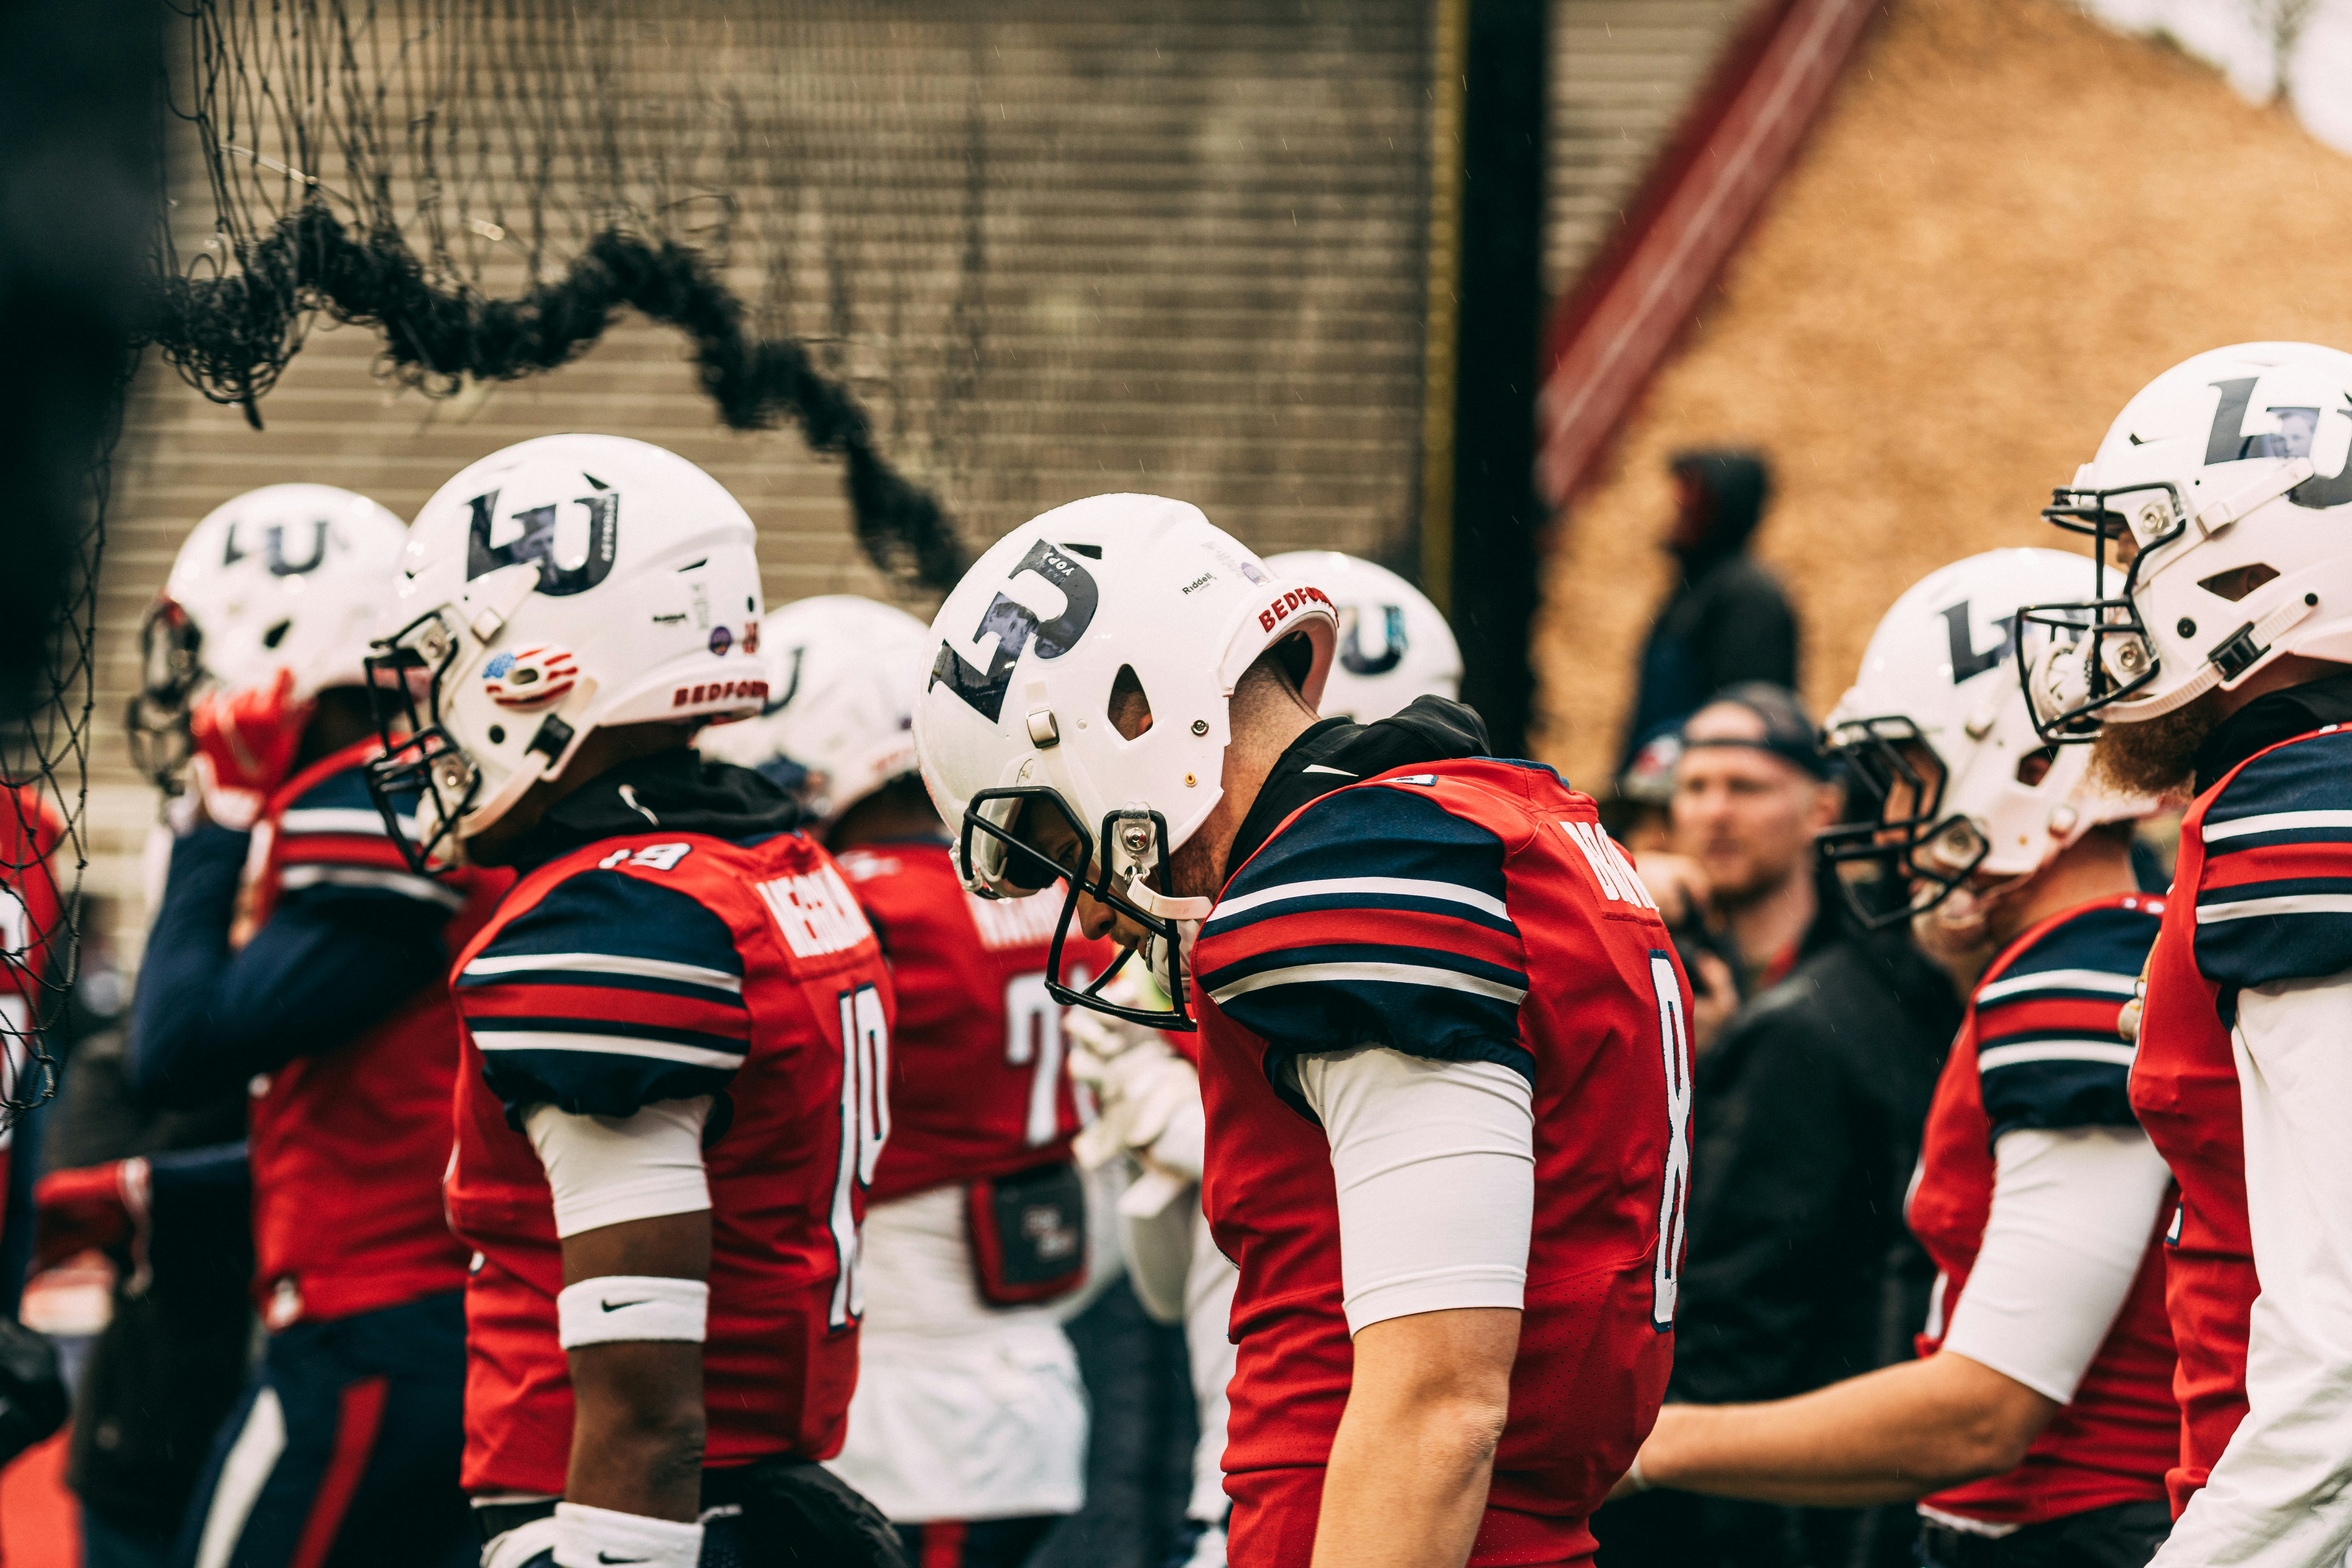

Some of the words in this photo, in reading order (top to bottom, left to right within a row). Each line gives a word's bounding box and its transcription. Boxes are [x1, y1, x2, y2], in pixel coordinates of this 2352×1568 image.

[463, 487, 619, 596] LU
[1182, 572, 1213, 595] Riddell
[1258, 586, 1339, 633] BEDFO
[929, 538, 1099, 724] LU
[672, 680, 769, 708] BEDFO
[1648, 949, 1693, 1333] 8
